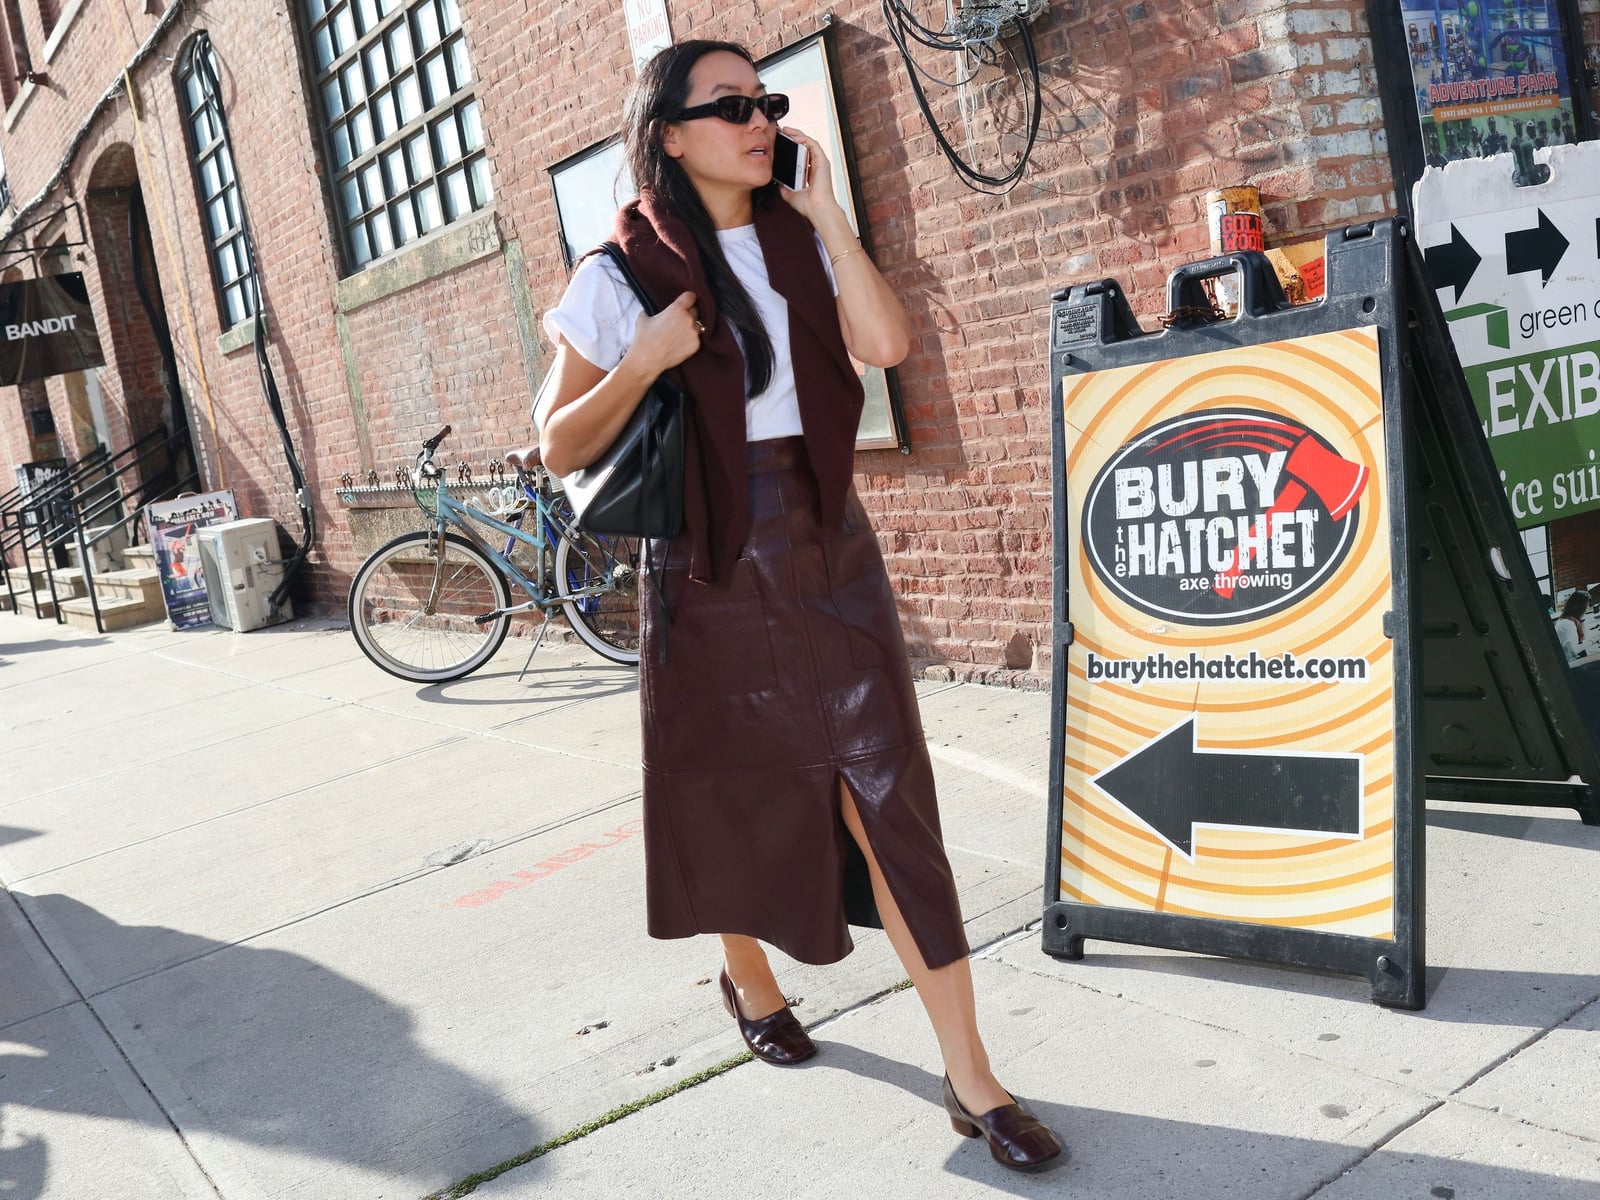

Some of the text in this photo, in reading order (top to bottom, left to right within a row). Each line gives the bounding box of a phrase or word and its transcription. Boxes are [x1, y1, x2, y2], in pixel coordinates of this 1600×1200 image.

[633, 13, 665, 48] PARKING
[1429, 72, 1558, 103] ADVENTURE PARK
[5, 314, 77, 341] BANDIT
[1520, 303, 1586, 339] green
[1482, 351, 1600, 438] EXIB
[1115, 450, 1288, 520] BURY
[1116, 526, 1126, 577] the
[1128, 508, 1318, 577] HATCHET
[1179, 571, 1292, 590] axe throwing
[1087, 651, 1366, 684] burythehatchet.com
